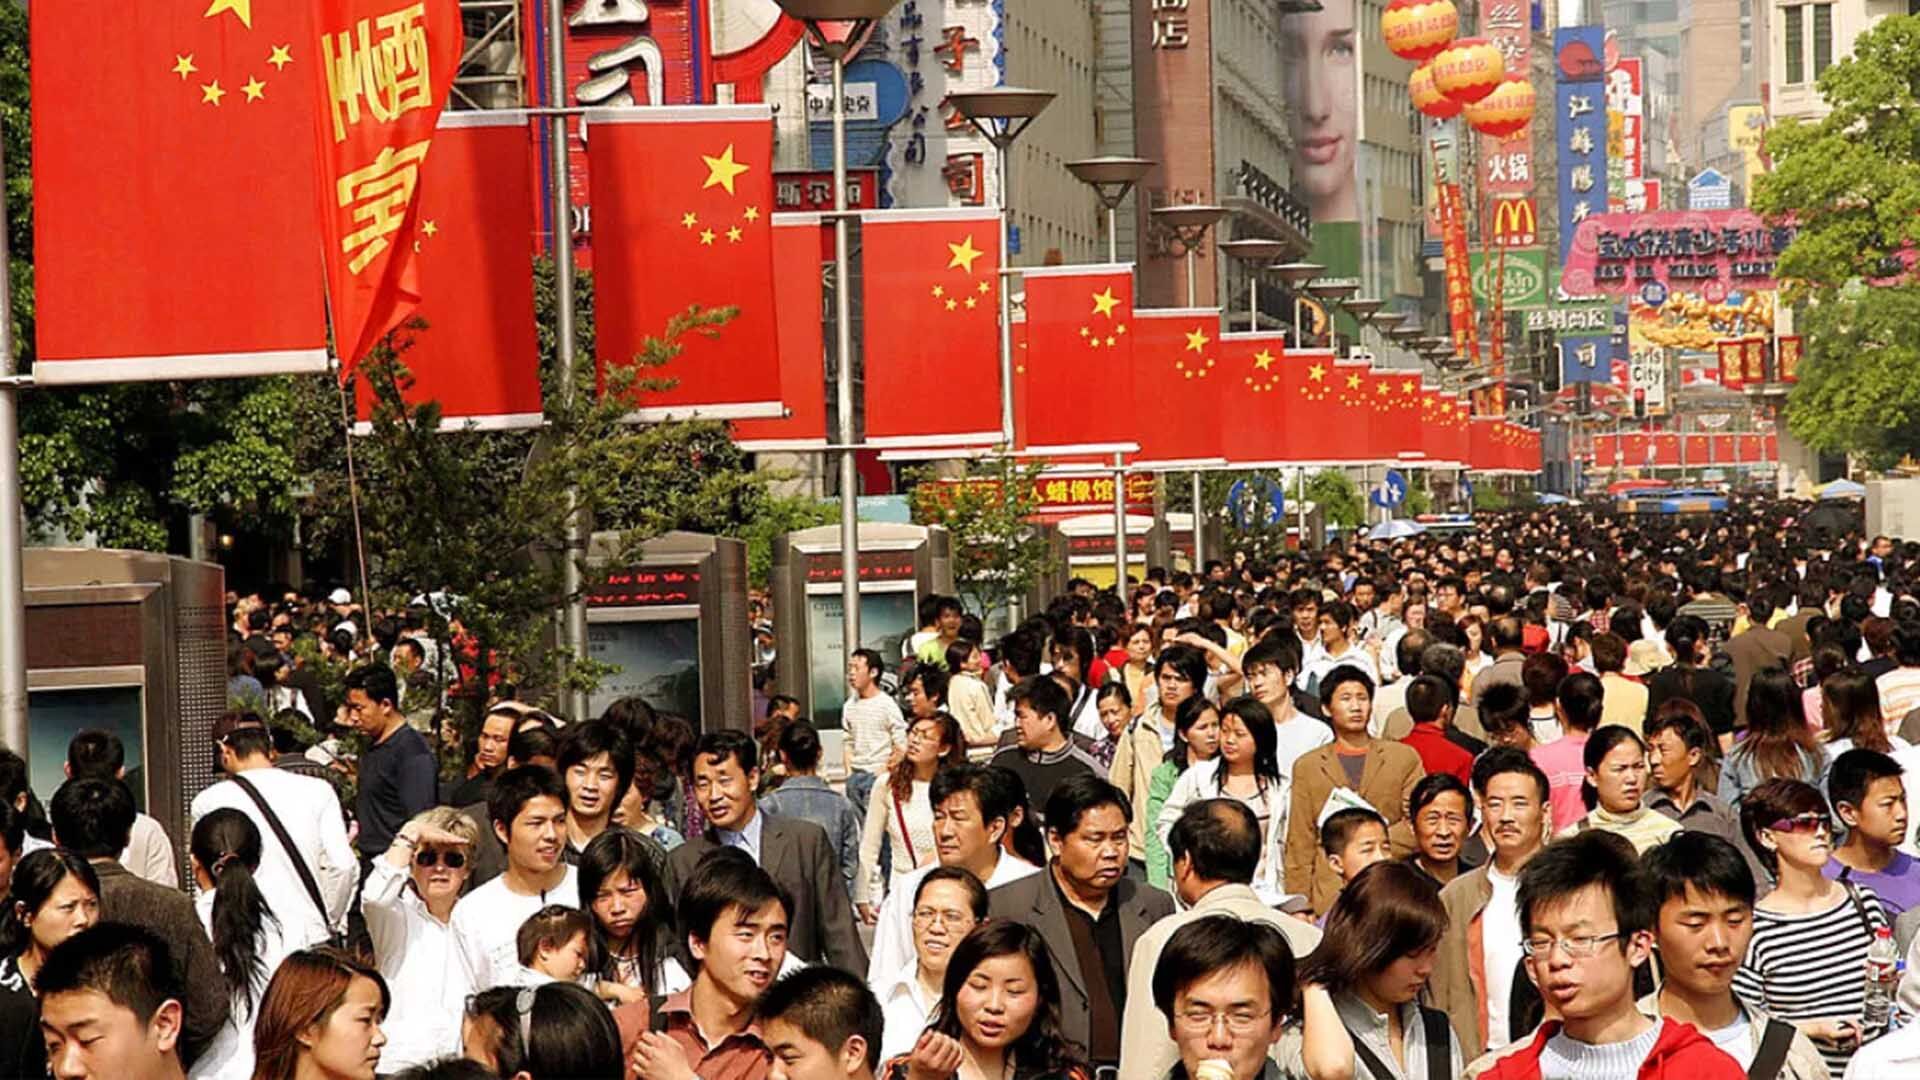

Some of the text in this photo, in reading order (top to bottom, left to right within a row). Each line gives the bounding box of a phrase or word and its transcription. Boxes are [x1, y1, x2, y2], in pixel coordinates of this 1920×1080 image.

[569, 0, 663, 106] 司
[1487, 153, 1529, 184] 火锅
[1633, 366, 1662, 384] City
